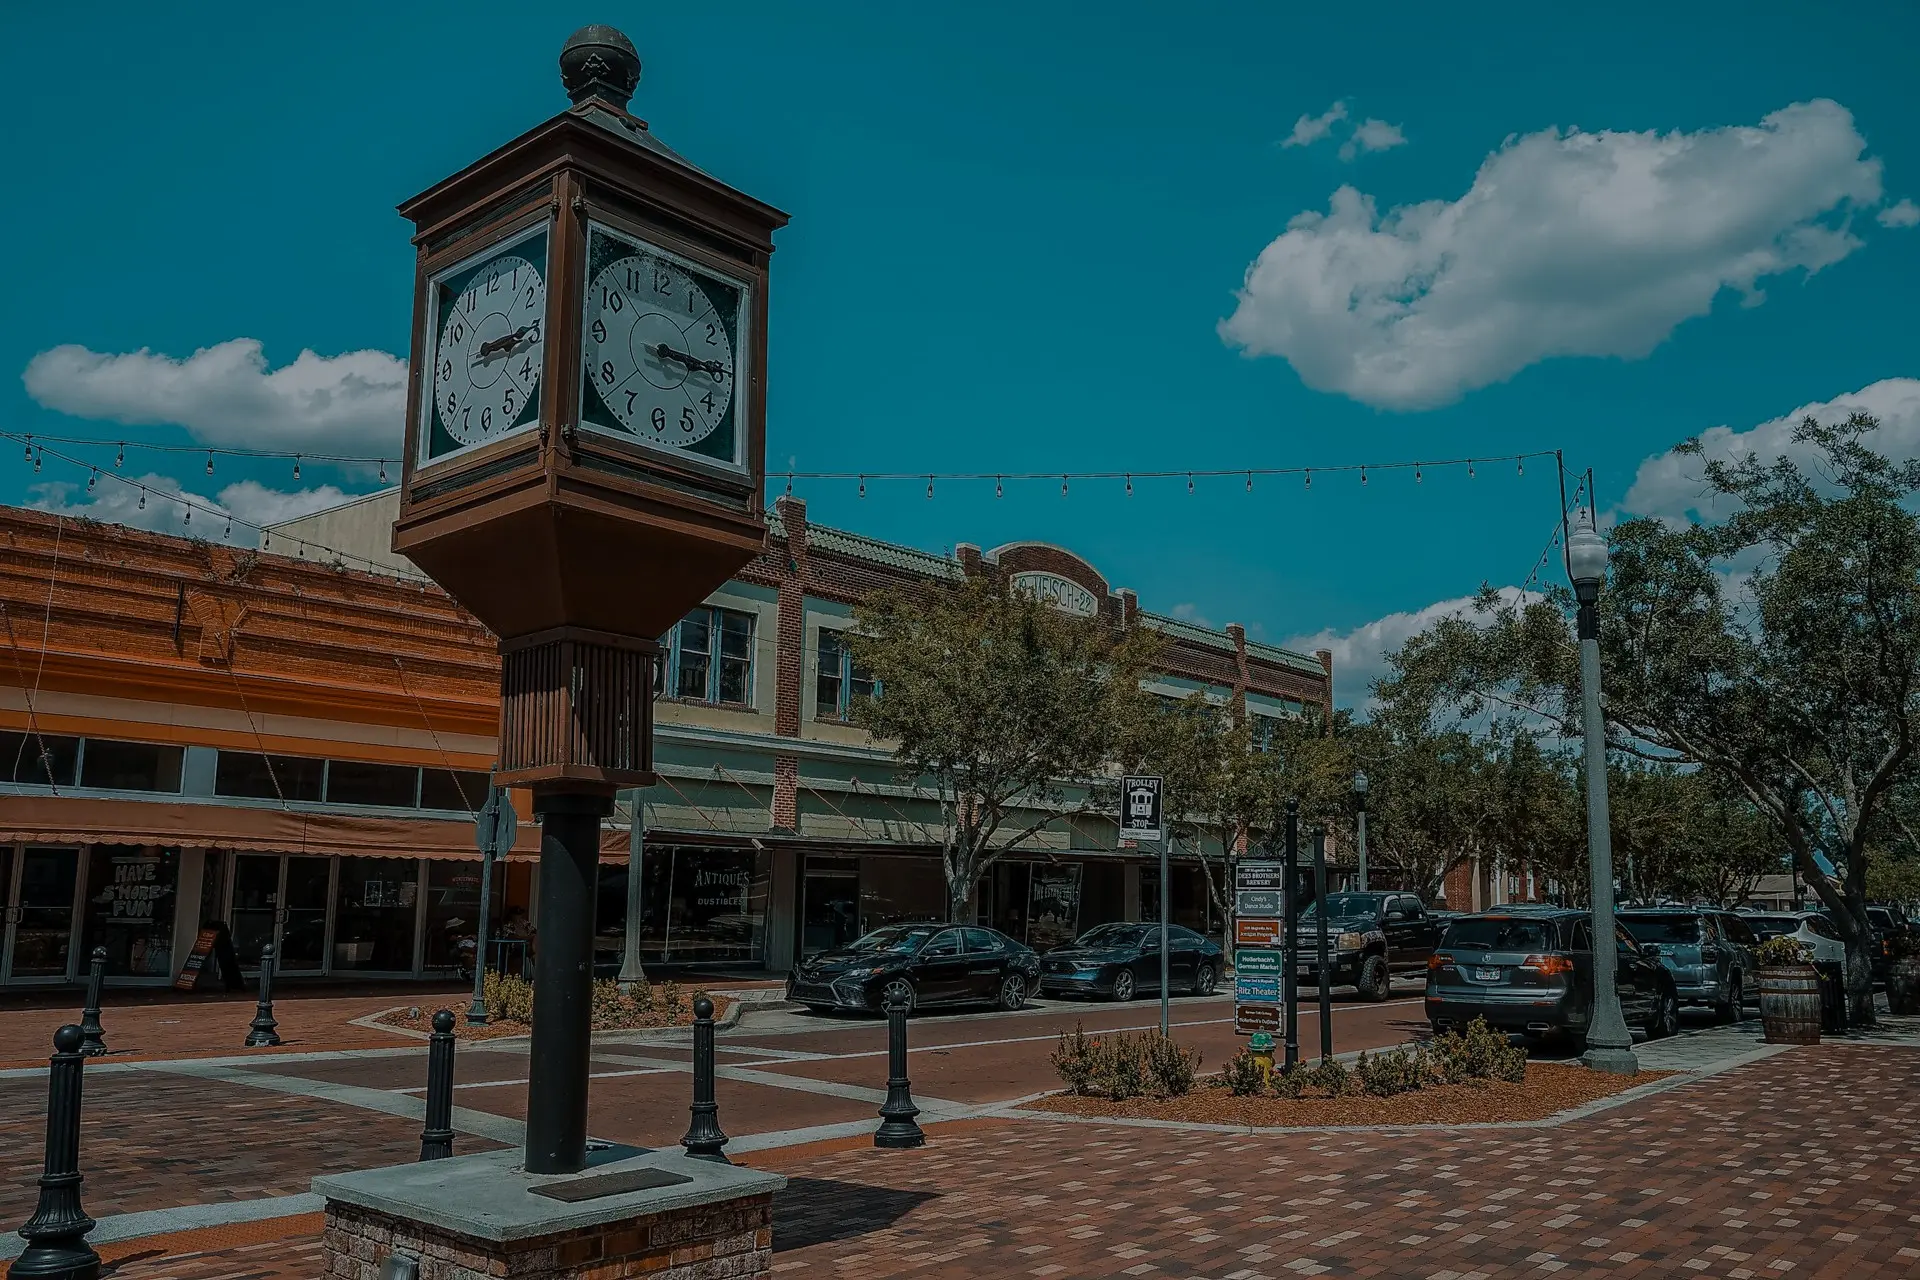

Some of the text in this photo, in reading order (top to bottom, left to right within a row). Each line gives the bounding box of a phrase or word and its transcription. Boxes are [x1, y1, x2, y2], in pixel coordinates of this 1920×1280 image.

[486, 270, 501, 297] 12
[512, 268, 518, 291] 1
[626, 267, 640, 294] 11
[653, 269, 672, 297] 12
[466, 289, 477, 313] 11
[525, 286, 535, 309] 2
[602, 286, 623, 314] 10
[688, 290, 694, 314] 1
[450, 322, 464, 347] 10
[592, 319, 607, 343] 9
[706, 323, 717, 346] 2
[442, 360, 452, 382] 9
[519, 356, 532, 382] 4
[602, 360, 616, 385] 8
[447, 391, 456, 415] 8
[502, 388, 515, 415] 5
[624, 389, 638, 416] 7
[700, 391, 716, 414] 4
[462, 405, 473, 432] 7
[481, 406, 492, 432] 6
[651, 408, 666, 432] 6
[679, 407, 695, 433] 5
[1125, 779, 1160, 794] TROLLEY
[1132, 819, 1149, 829] STOP
[114, 863, 157, 883] HAVE
[694, 869, 750, 888] ANTIQUES
[113, 900, 153, 917] FUN
[698, 898, 742, 906] DUSTIBLES
[1239, 987, 1277, 995] Ritz Theater
